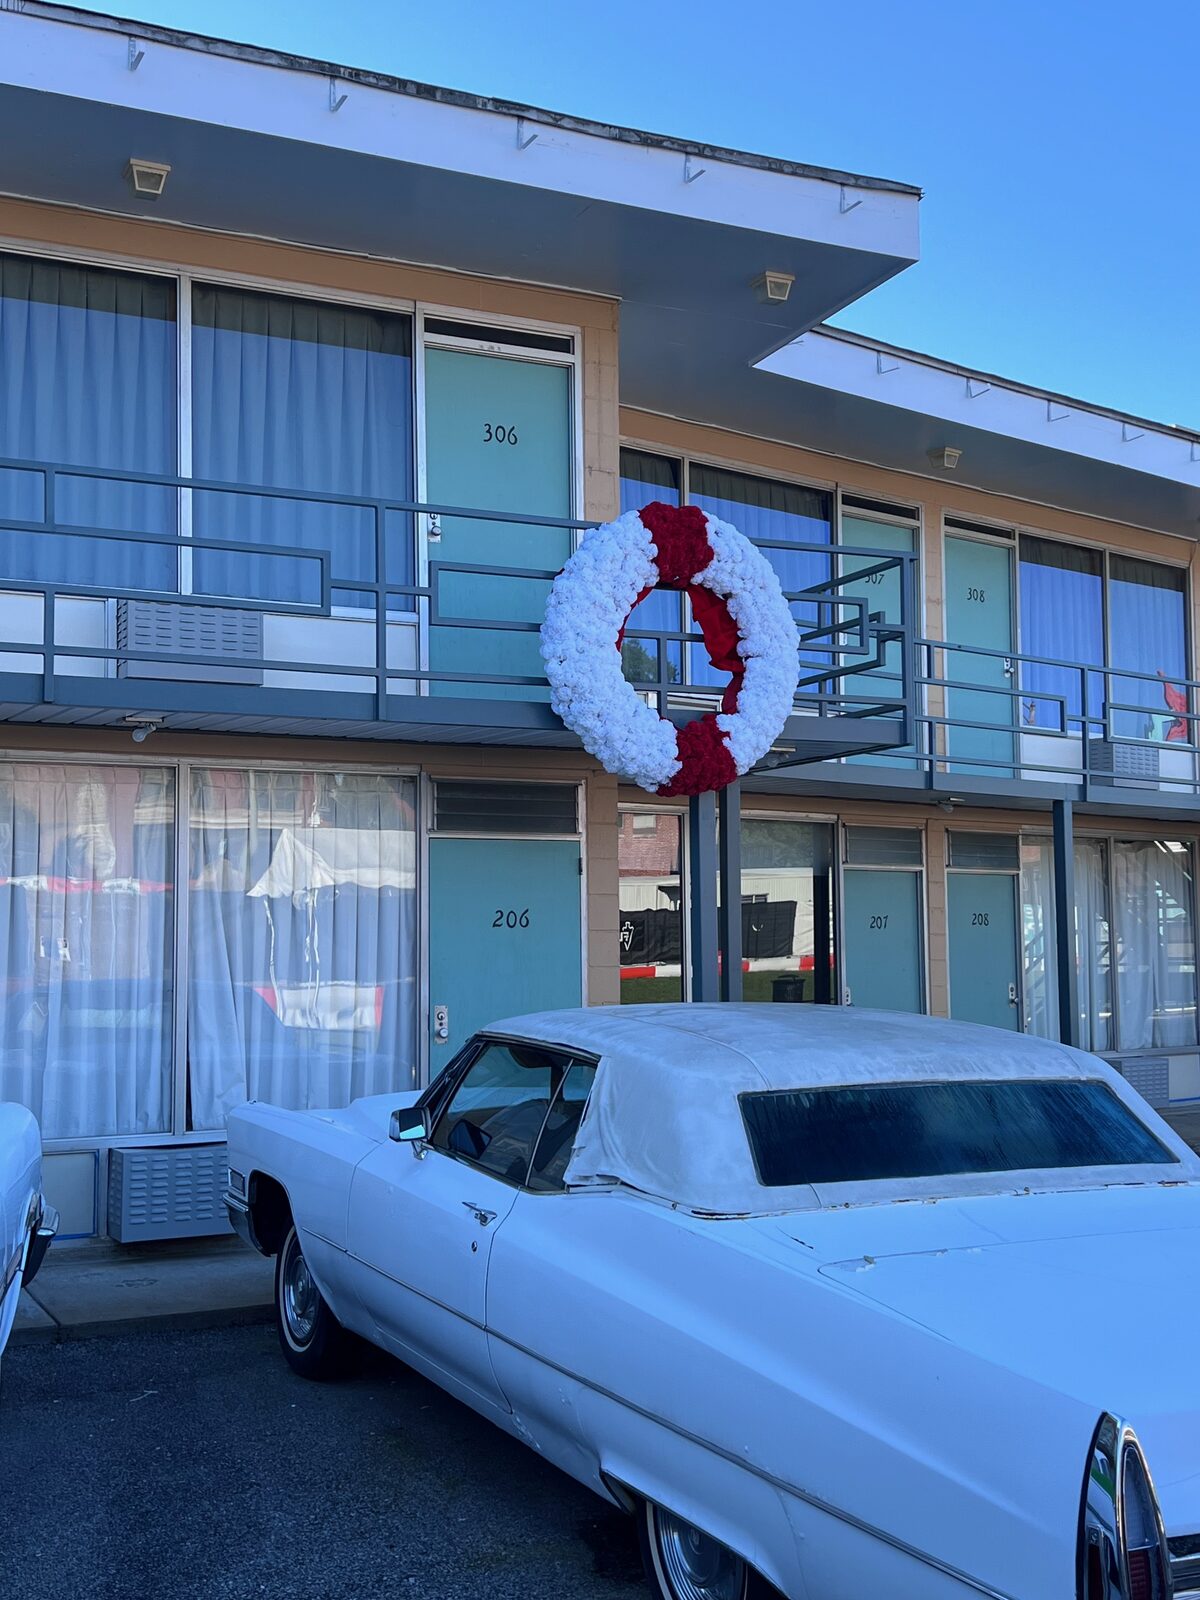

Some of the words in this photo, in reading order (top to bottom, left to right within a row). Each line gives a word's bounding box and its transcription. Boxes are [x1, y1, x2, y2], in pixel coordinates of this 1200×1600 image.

[483, 423, 518, 446] 306
[966, 587, 986, 603] 308
[492, 908, 530, 929] 206
[869, 915, 889, 930] 207
[971, 912, 990, 927] 208
